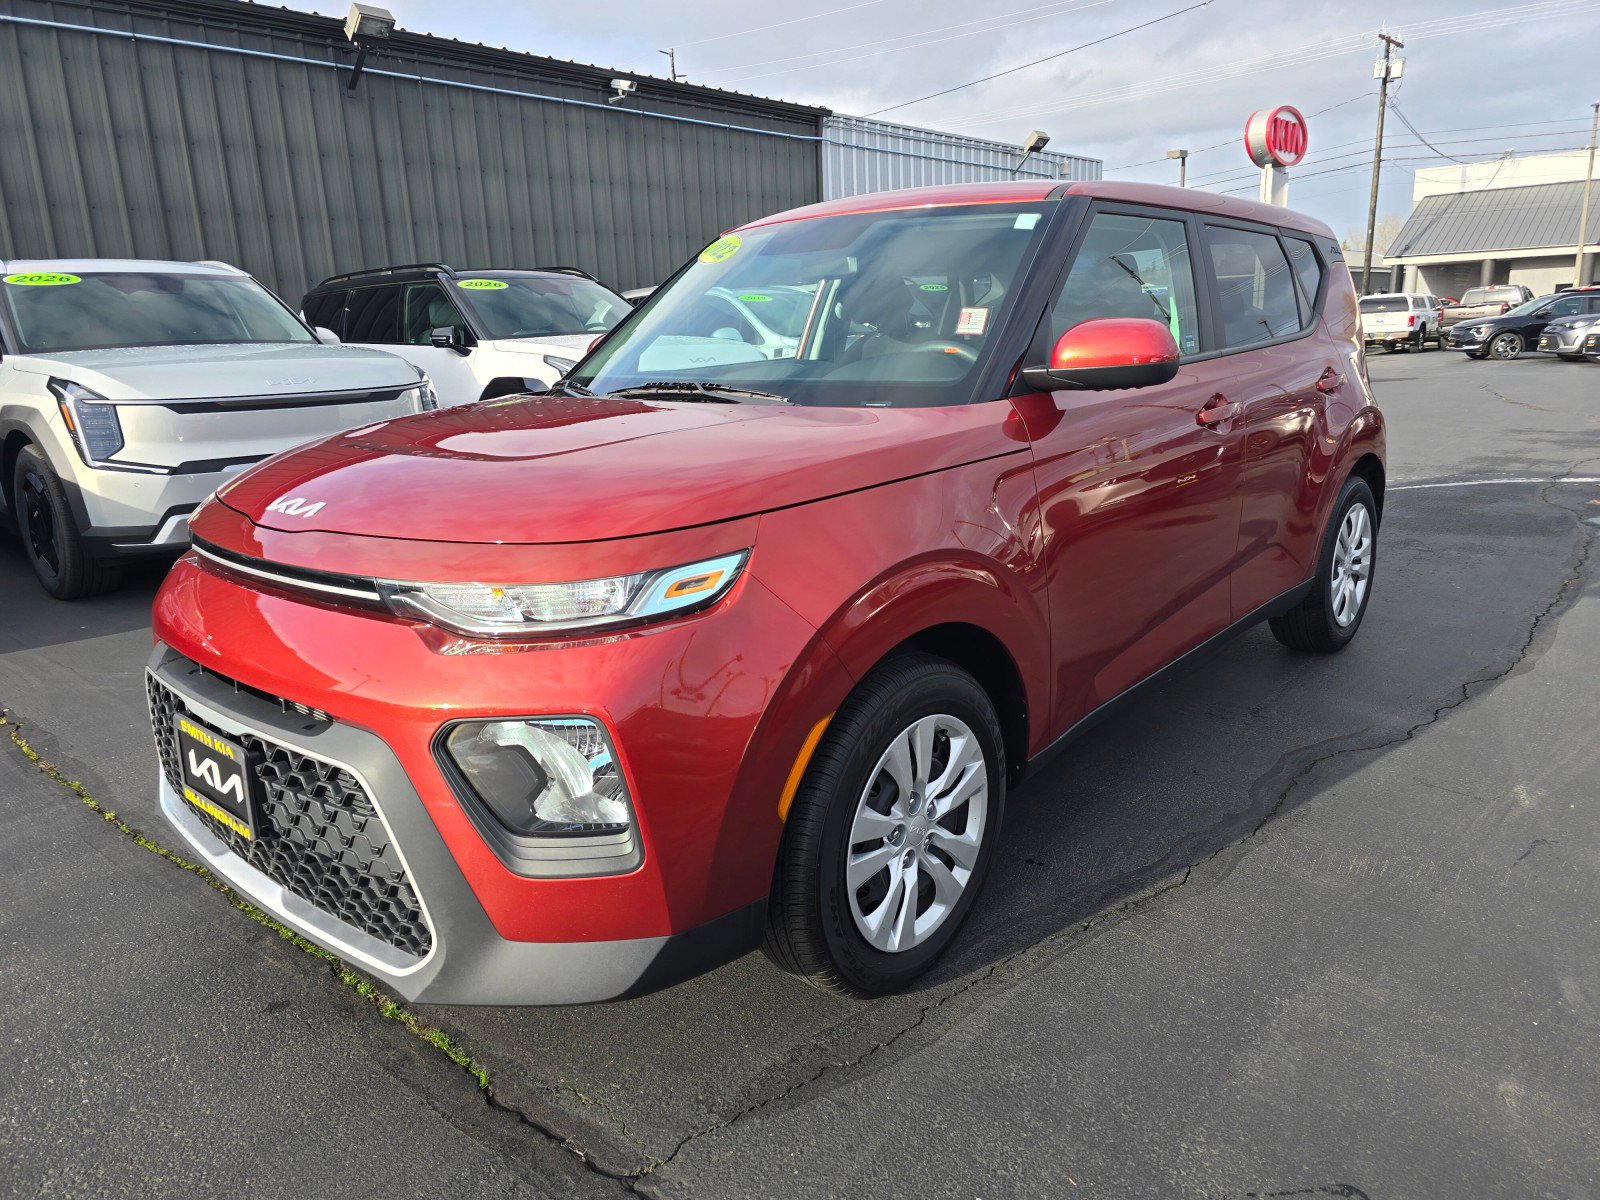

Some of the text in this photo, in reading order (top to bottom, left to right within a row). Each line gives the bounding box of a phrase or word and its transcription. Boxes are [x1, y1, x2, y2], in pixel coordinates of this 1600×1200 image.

[1273, 117, 1302, 155] KIA
[13, 275, 71, 283] 2026
[265, 495, 327, 518] KIA
[180, 719, 234, 760] SMITH KIA
[188, 748, 244, 804] KIA
[184, 787, 252, 841] BELLINGHAM
